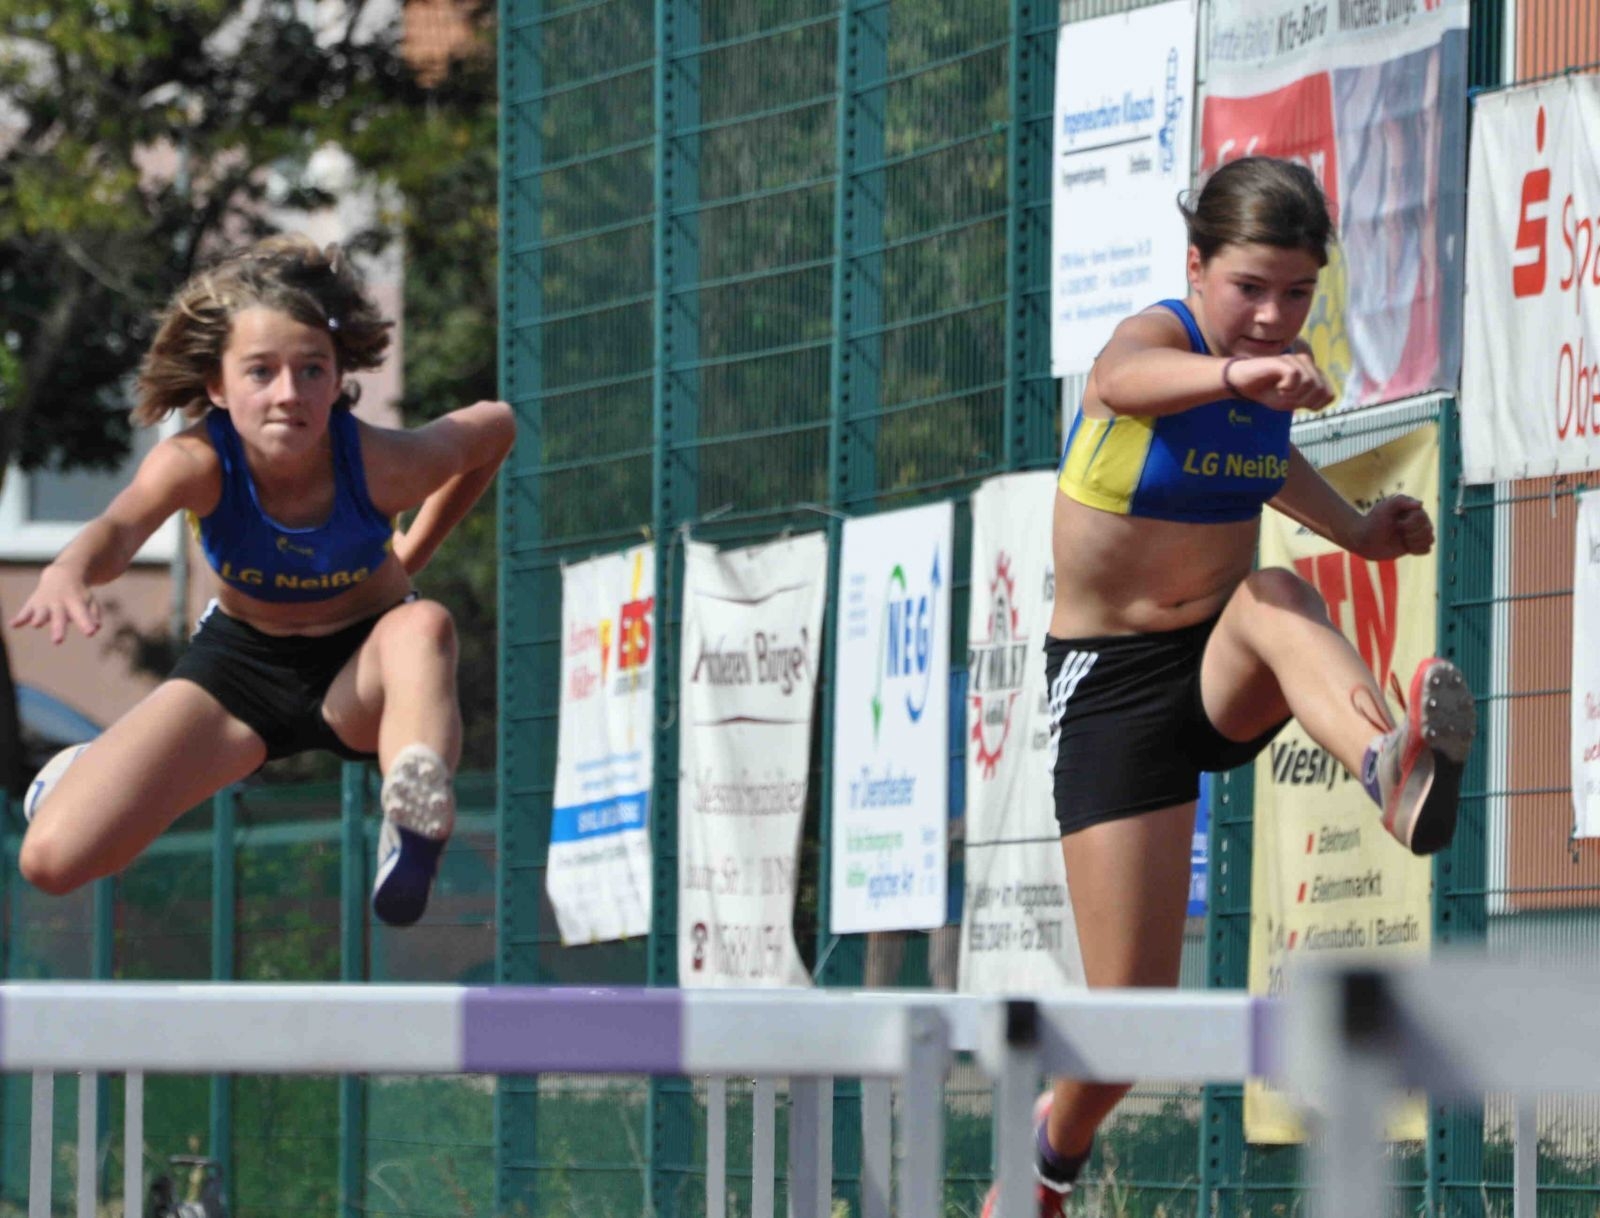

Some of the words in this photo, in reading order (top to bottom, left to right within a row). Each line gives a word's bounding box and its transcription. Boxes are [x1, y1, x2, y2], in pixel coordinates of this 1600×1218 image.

[1183, 448, 1219, 476] LG
[1225, 453, 1289, 479] Neiße
[222, 562, 262, 585] LG
[275, 567, 369, 589] Neiße
[887, 595, 929, 677] NEG
